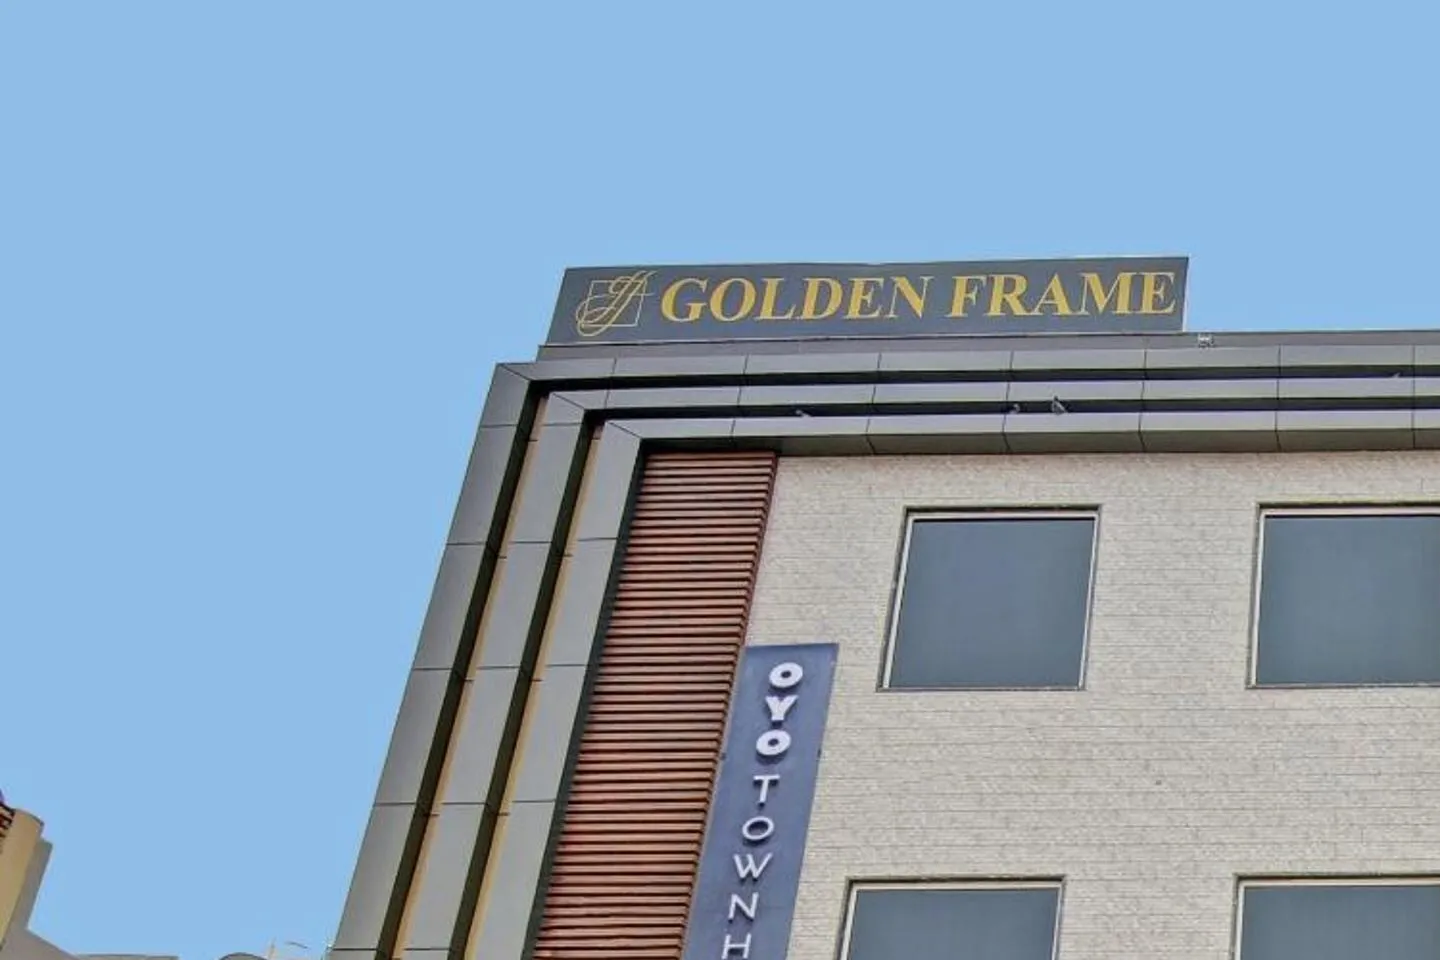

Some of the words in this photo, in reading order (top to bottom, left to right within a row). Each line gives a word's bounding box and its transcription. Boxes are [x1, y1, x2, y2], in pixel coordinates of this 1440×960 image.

[660, 275, 927, 323] GOLDEN
[945, 271, 1176, 319] FRAME
[755, 662, 804, 758] OYO
